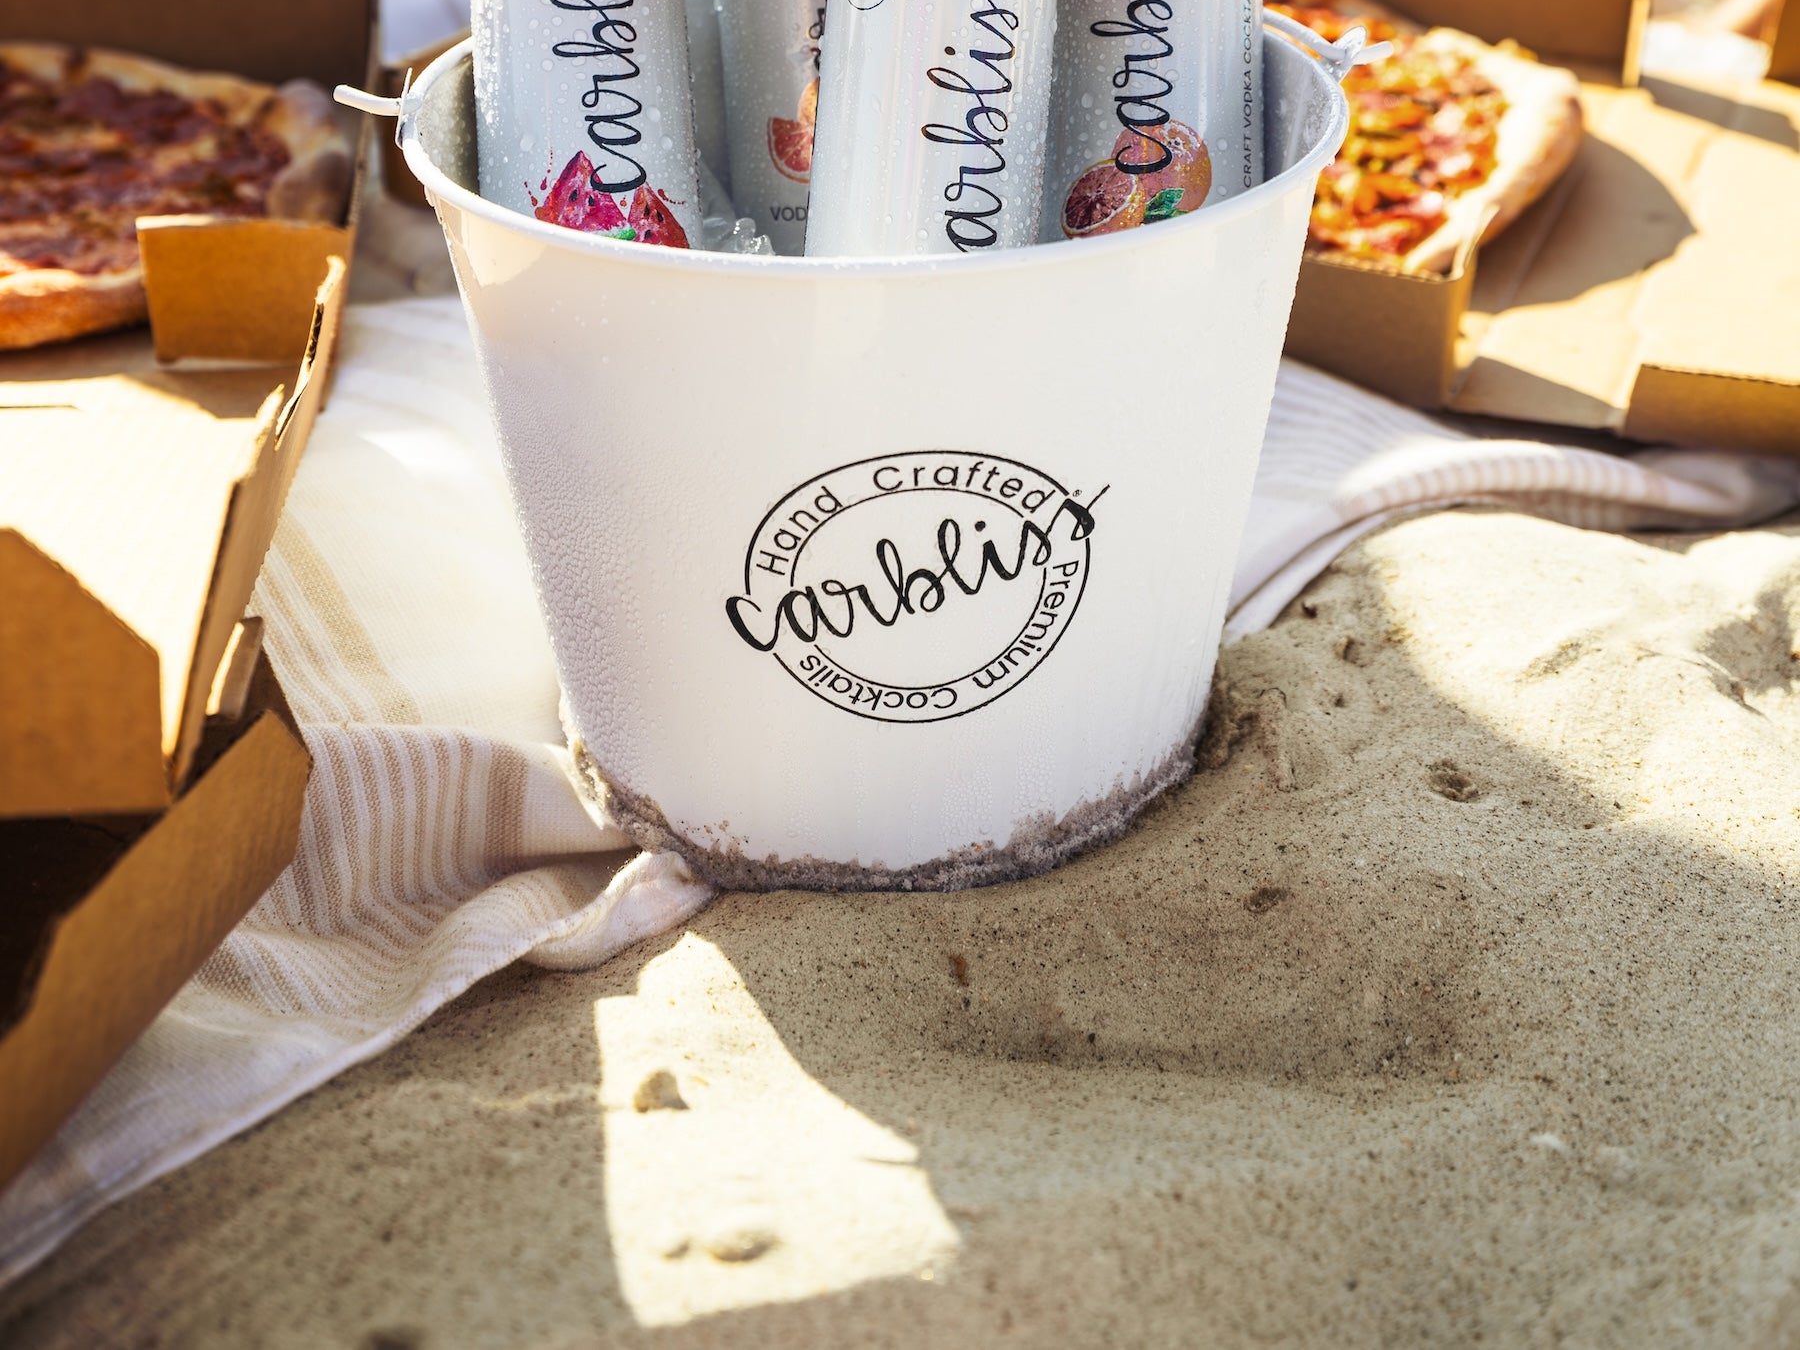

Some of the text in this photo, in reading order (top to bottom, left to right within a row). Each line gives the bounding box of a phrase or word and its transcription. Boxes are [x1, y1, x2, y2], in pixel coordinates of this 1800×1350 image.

[1243, 69, 1253, 128] VODKA
[1243, 134, 1252, 188] CRAFT
[769, 206, 808, 221] VOD
[756, 461, 1056, 575] Hand Crafted
[799, 560, 1079, 711] Premium Cocktails
